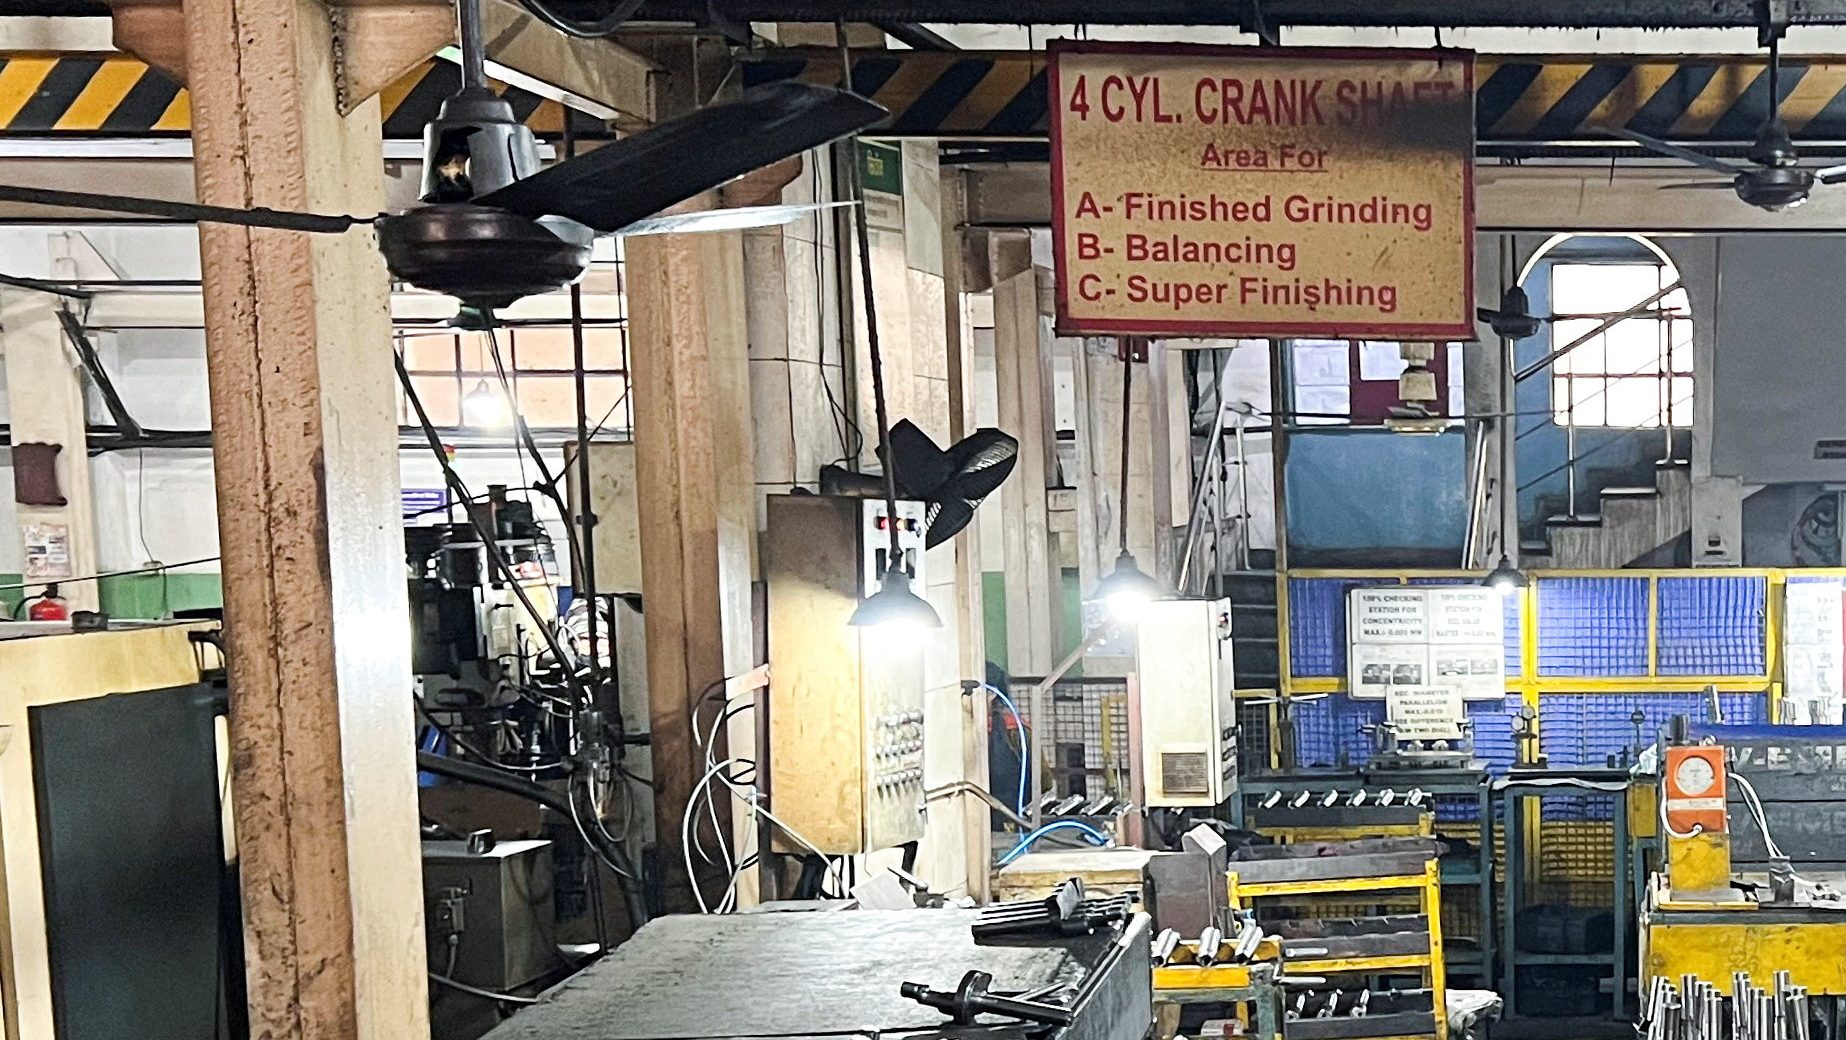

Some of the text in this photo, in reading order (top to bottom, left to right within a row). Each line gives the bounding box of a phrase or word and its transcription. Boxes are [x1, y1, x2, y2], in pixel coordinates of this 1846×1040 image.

[1069, 74, 1090, 121] 4
[1101, 75, 1182, 123] CYL.
[1195, 77, 1325, 126] CRANK
[1201, 143, 1328, 168] Area For
[1075, 191, 1432, 231] A- Finished Grinding
[1077, 233, 1296, 270] B- Balancing
[1078, 273, 1397, 313] C- Super Finishing
